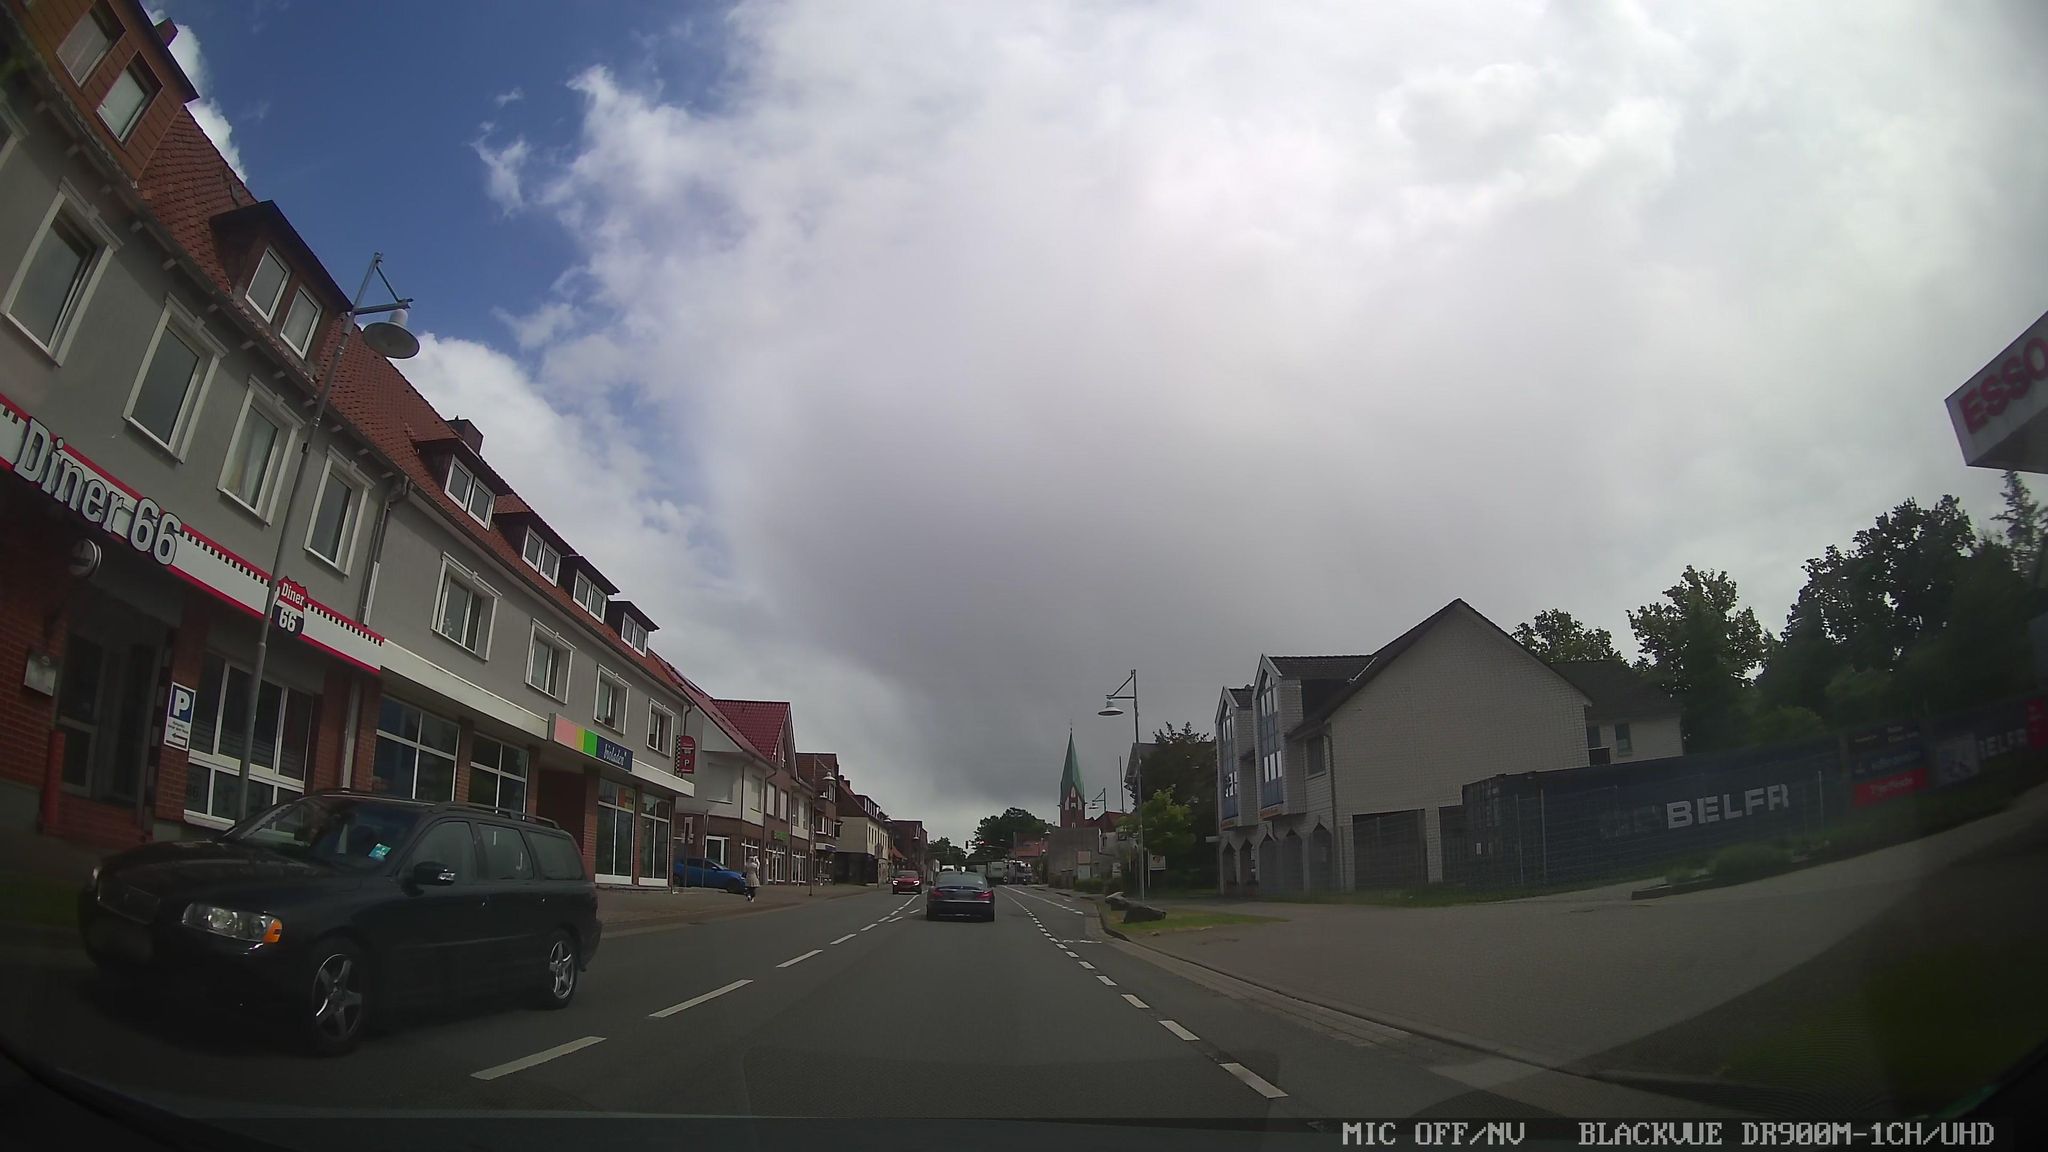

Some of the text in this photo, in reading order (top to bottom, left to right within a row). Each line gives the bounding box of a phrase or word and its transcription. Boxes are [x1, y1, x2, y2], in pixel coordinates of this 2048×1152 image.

[14, 416, 182, 566] Diner 66
[281, 582, 305, 606] Diner
[279, 609, 296, 632] 66
[173, 689, 190, 717] P
[684, 759, 690, 767] P
